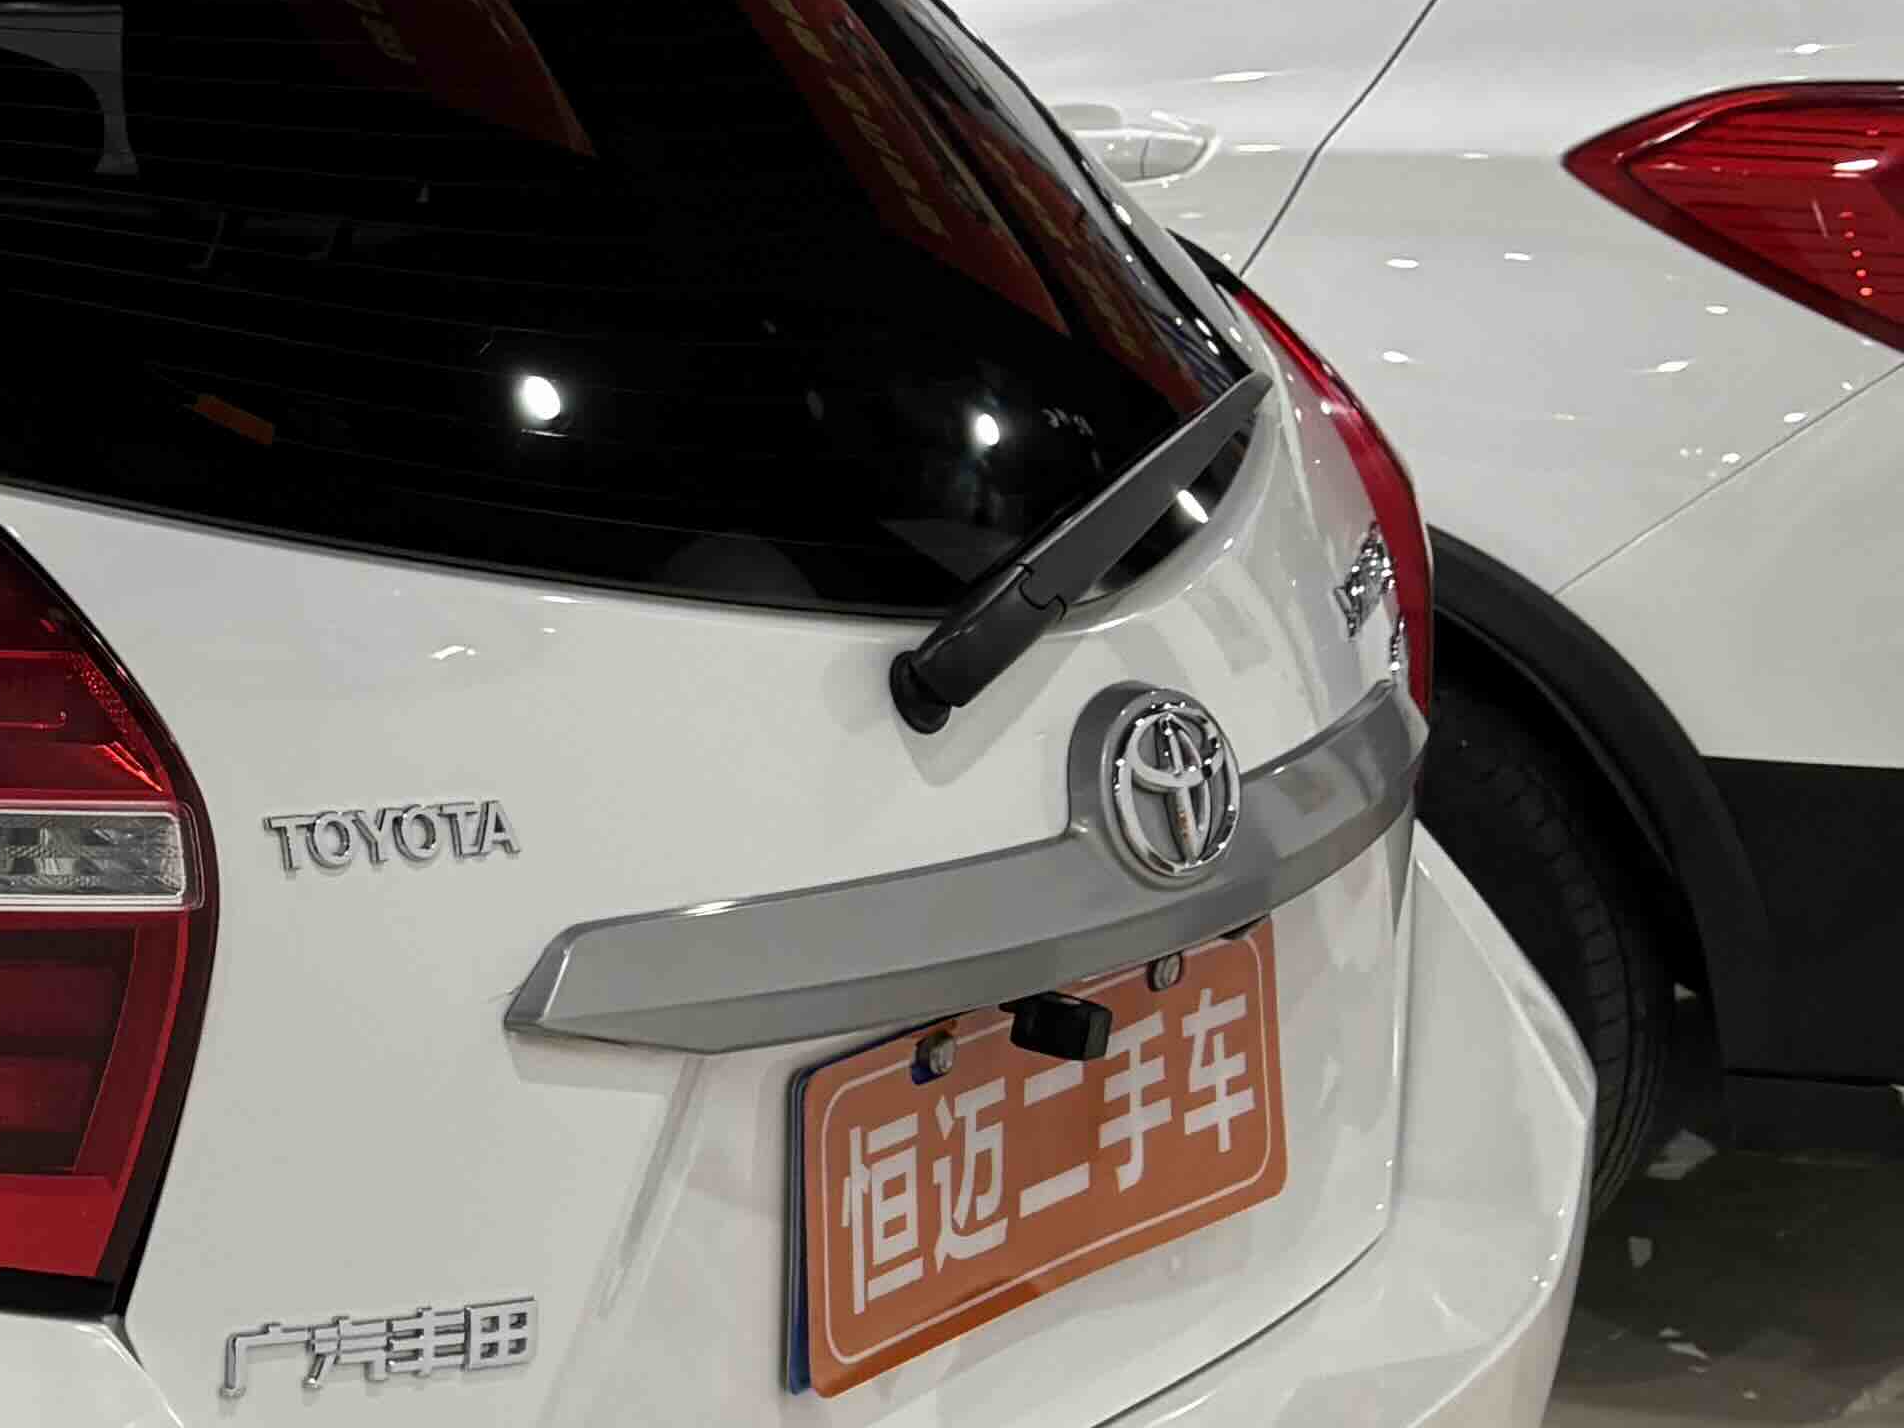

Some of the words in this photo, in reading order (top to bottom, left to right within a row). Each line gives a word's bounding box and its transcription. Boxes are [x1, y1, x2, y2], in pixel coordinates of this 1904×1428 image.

[262, 798, 522, 876] TOYOTA
[842, 987, 1256, 1315] 恒迈二手车
[220, 1292, 539, 1397] 广汽丰田
